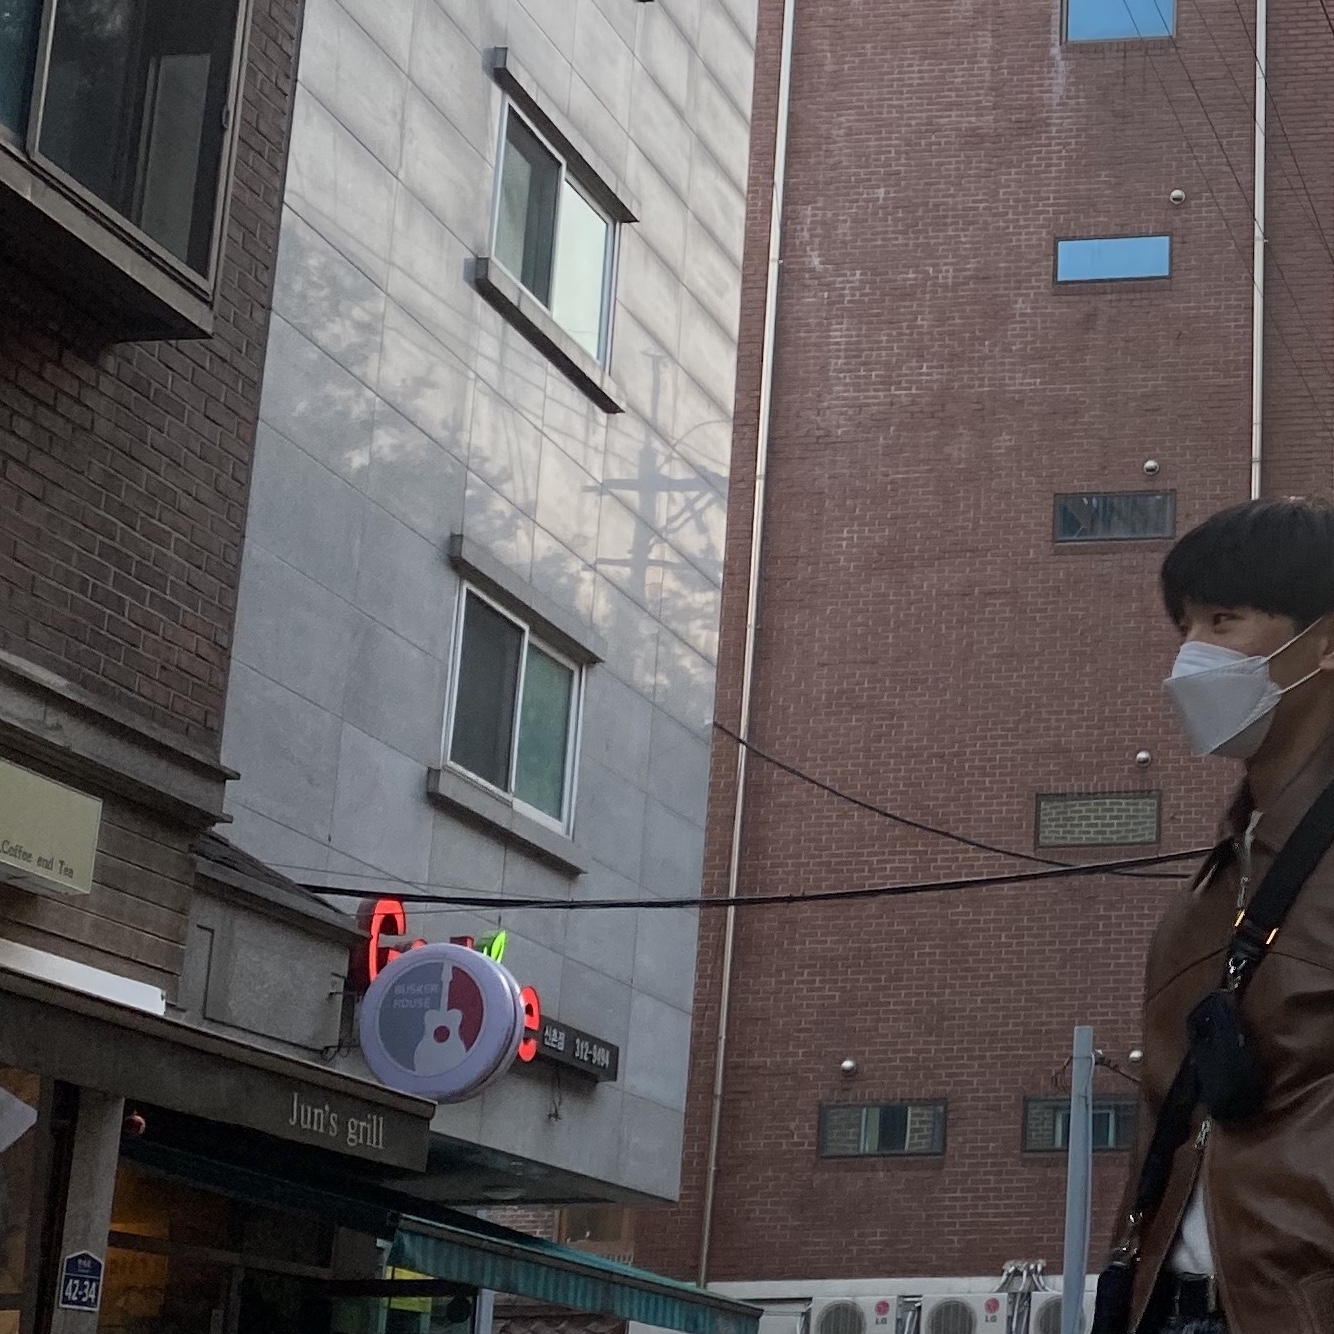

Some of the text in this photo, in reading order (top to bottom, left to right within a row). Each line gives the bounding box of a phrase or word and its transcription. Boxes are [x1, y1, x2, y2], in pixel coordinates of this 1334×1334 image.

[1, 839, 74, 879] Coffee and Tea
[289, 1092, 383, 1149] Jun's grill
[985, 1315, 997, 1323] LG
